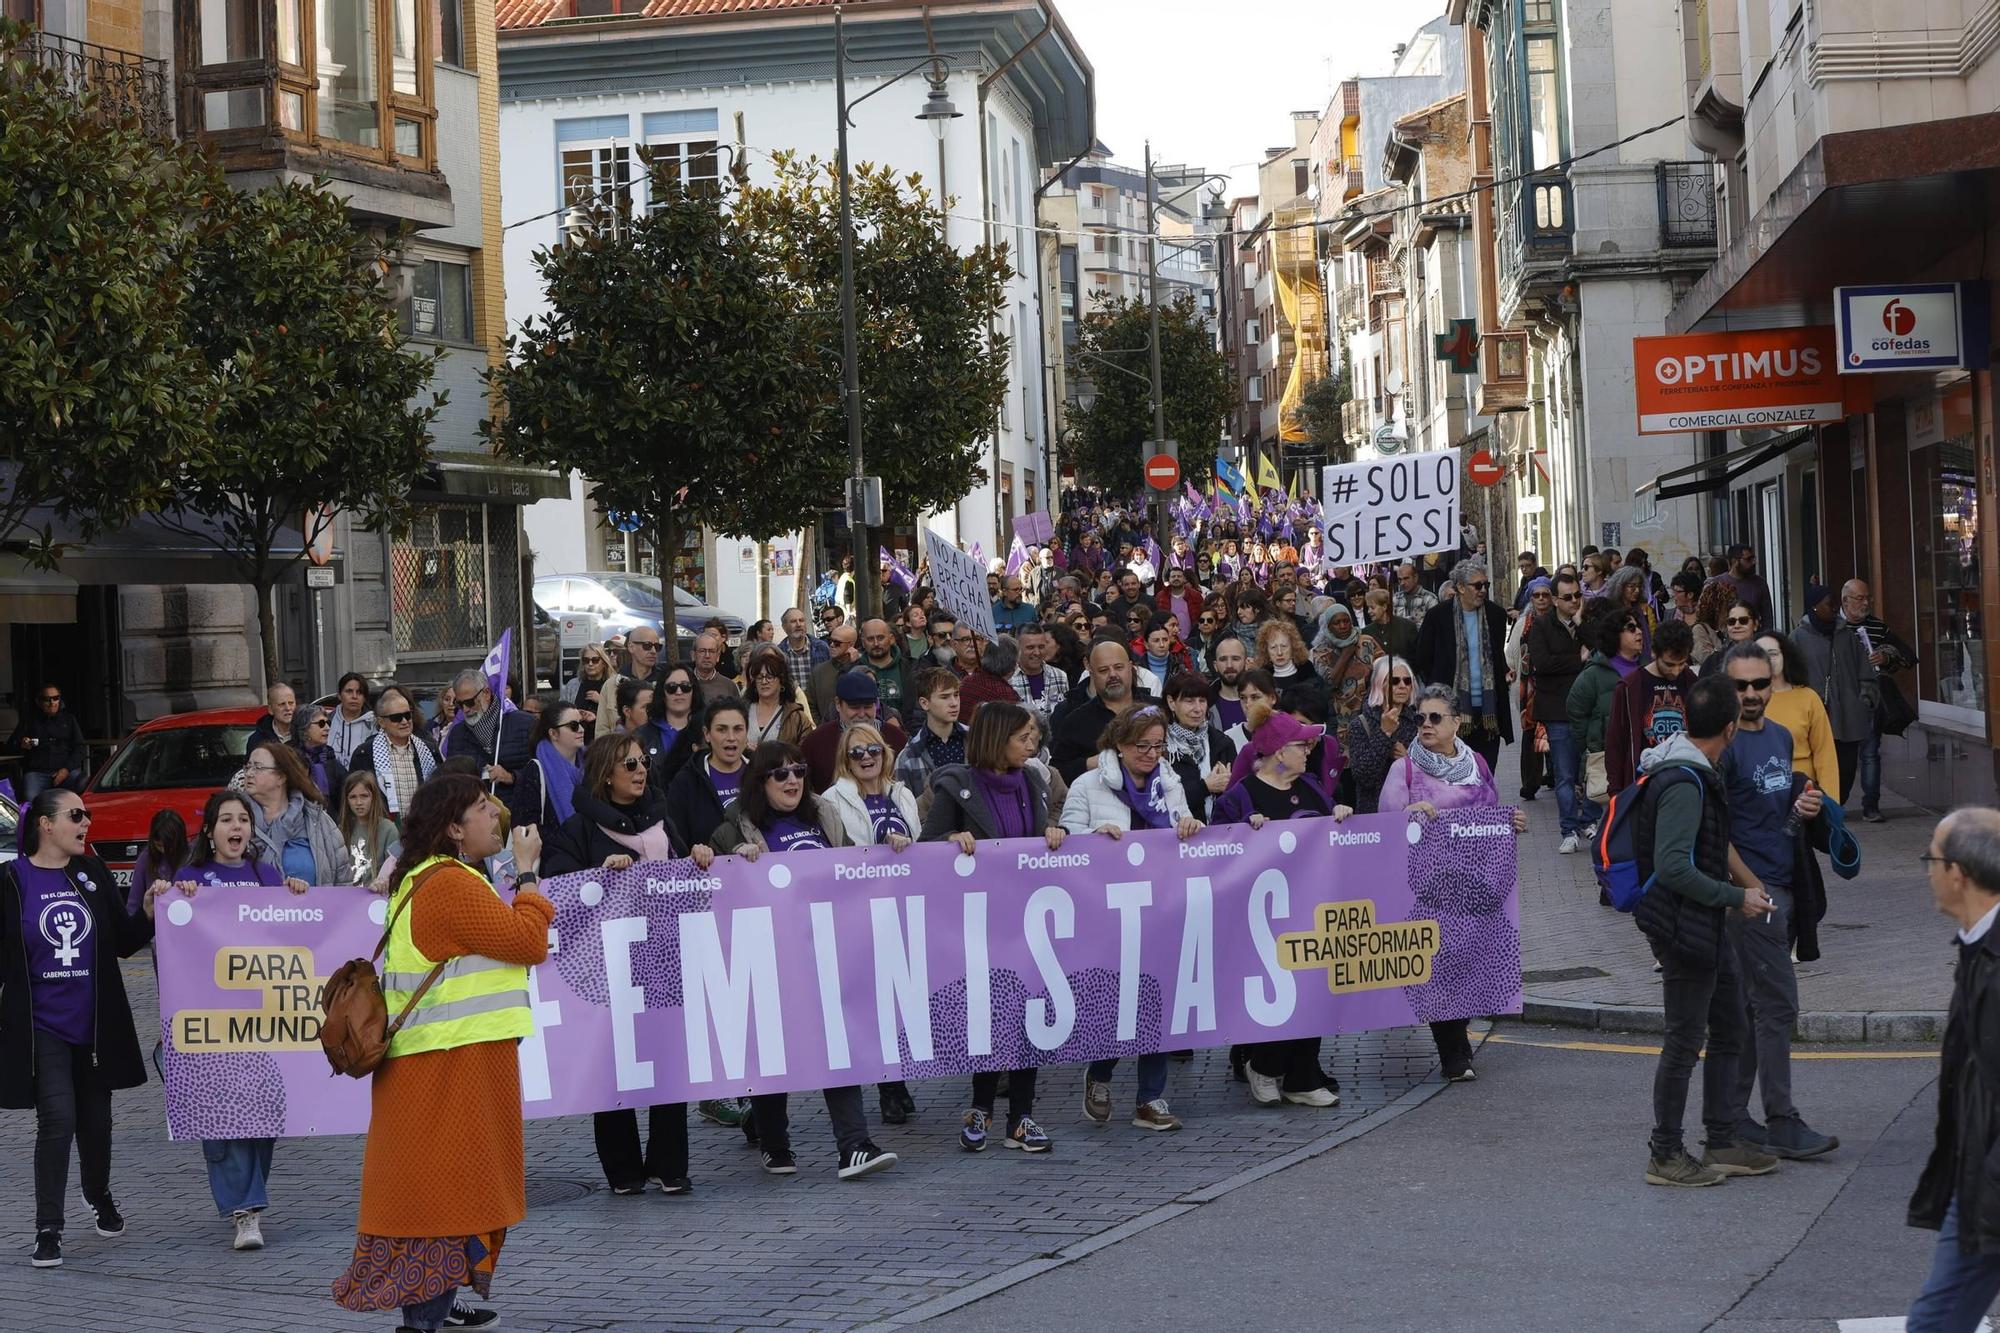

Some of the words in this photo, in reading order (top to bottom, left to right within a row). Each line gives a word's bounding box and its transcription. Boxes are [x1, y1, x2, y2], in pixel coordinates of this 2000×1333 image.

[1872, 338, 1931, 351] cofedas
[1655, 347, 1822, 384] OPTIMUS
[1721, 382, 1767, 391] CONFIANZA
[1669, 413, 1744, 429] COMERCIAL
[1746, 409, 1816, 423] GONZALEZ
[1375, 513, 1413, 556] ES
[1423, 498, 1454, 547] SÍ
[931, 536, 949, 563] NO
[952, 552, 960, 571] A
[963, 558, 979, 584] LA
[937, 563, 985, 611] BRECHA
[936, 584, 993, 638] SALARIAL
[1329, 829, 1381, 847] Podemos
[1450, 822, 1511, 838] Podemos
[1017, 852, 1091, 870] Podemos
[1178, 841, 1244, 860] Podemos
[834, 862, 911, 881] Podemos
[646, 874, 723, 896] Podemos
[238, 904, 324, 922] Podemos
[1325, 906, 1371, 933] PARA
[1285, 926, 1434, 963] TRANSFORMAR
[42, 970, 71, 979] CABEMOS
[71, 969, 90, 977] TODAS
[228, 954, 307, 981] PARA
[1334, 962, 1355, 987] EL
[1359, 954, 1425, 985] MUNDO
[184, 1017, 221, 1044] EL
[228, 1015, 321, 1044] MUND
